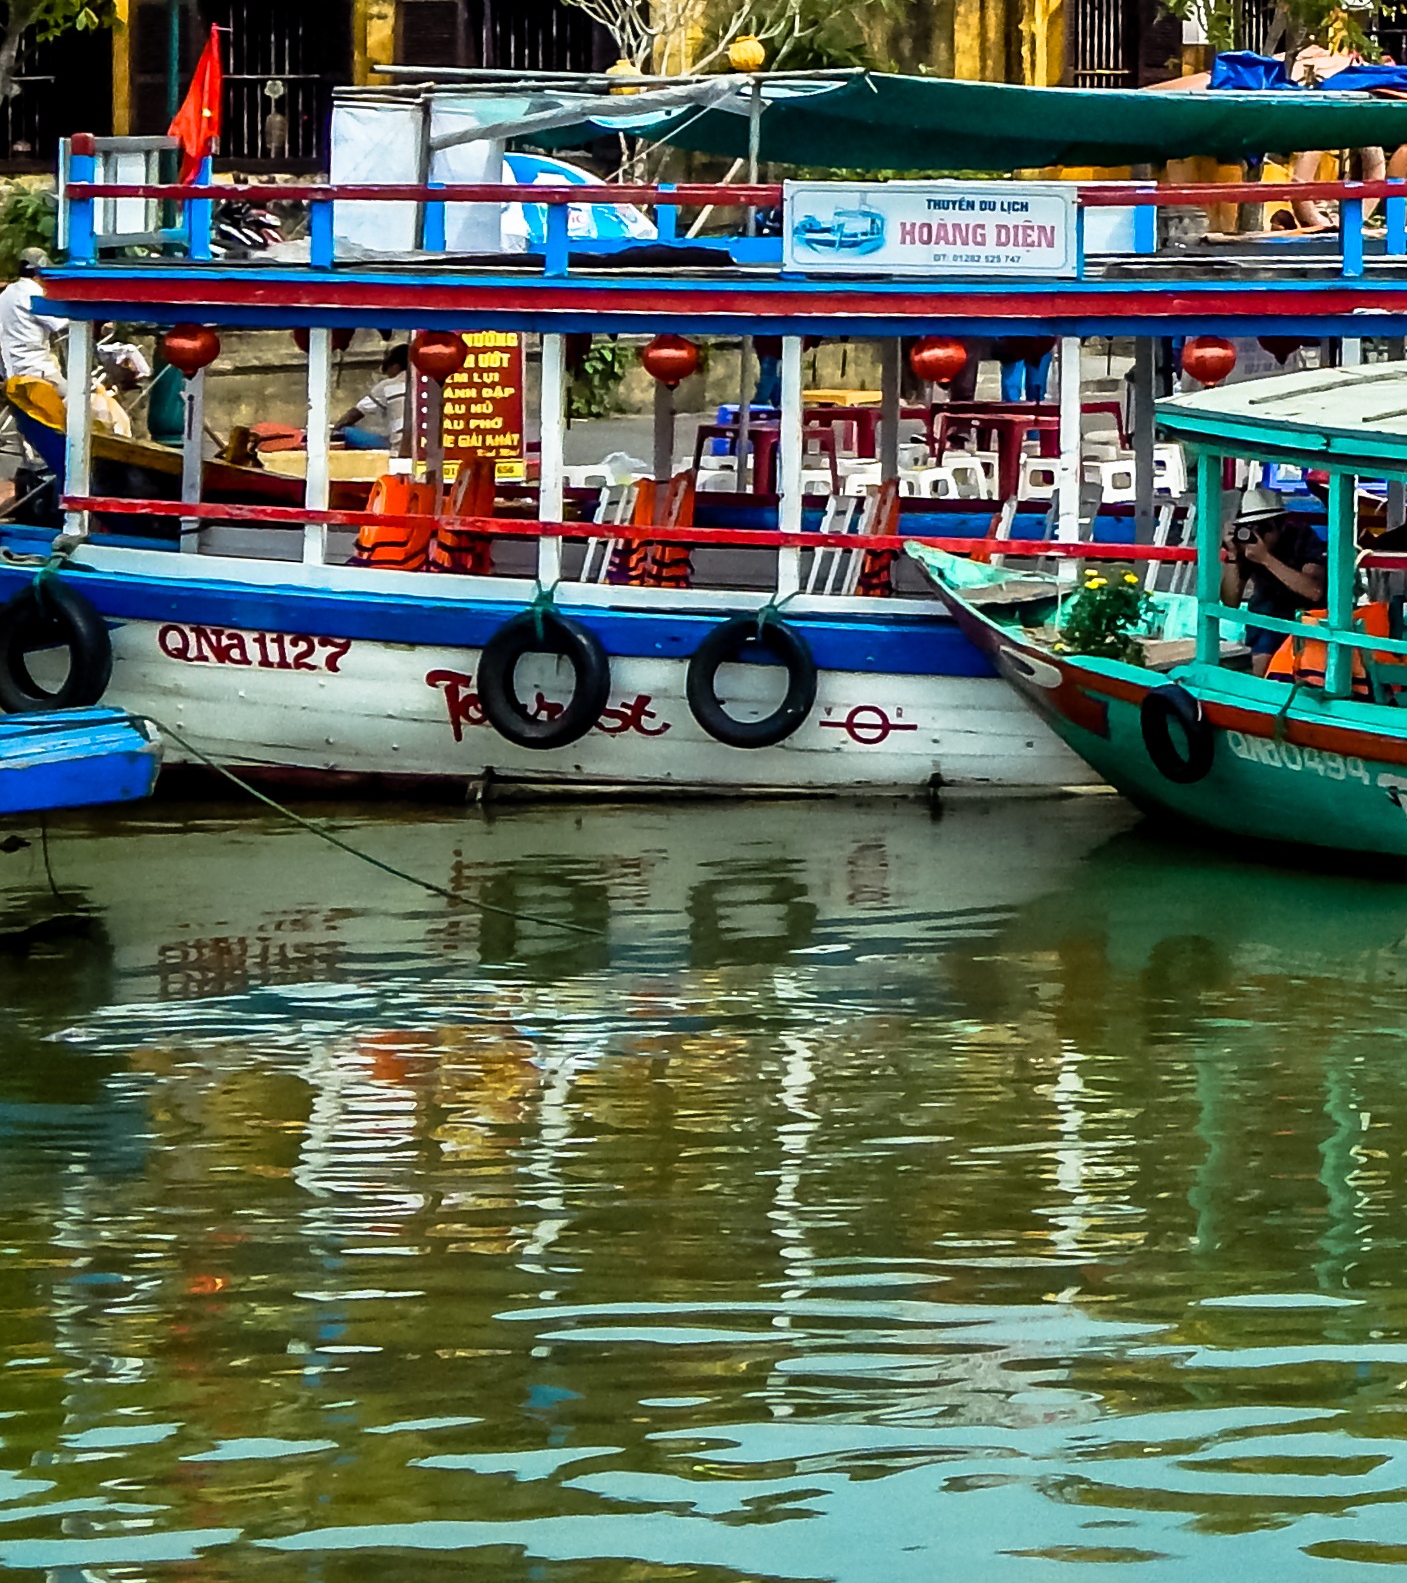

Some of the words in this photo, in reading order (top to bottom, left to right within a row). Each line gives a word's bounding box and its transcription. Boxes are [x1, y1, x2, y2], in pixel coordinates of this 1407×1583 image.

[1000, 200, 1029, 215] LỊCH
[900, 218, 987, 247] HOÀNG
[443, 386, 477, 399] ÁNH
[158, 623, 351, 673] QNa1127
